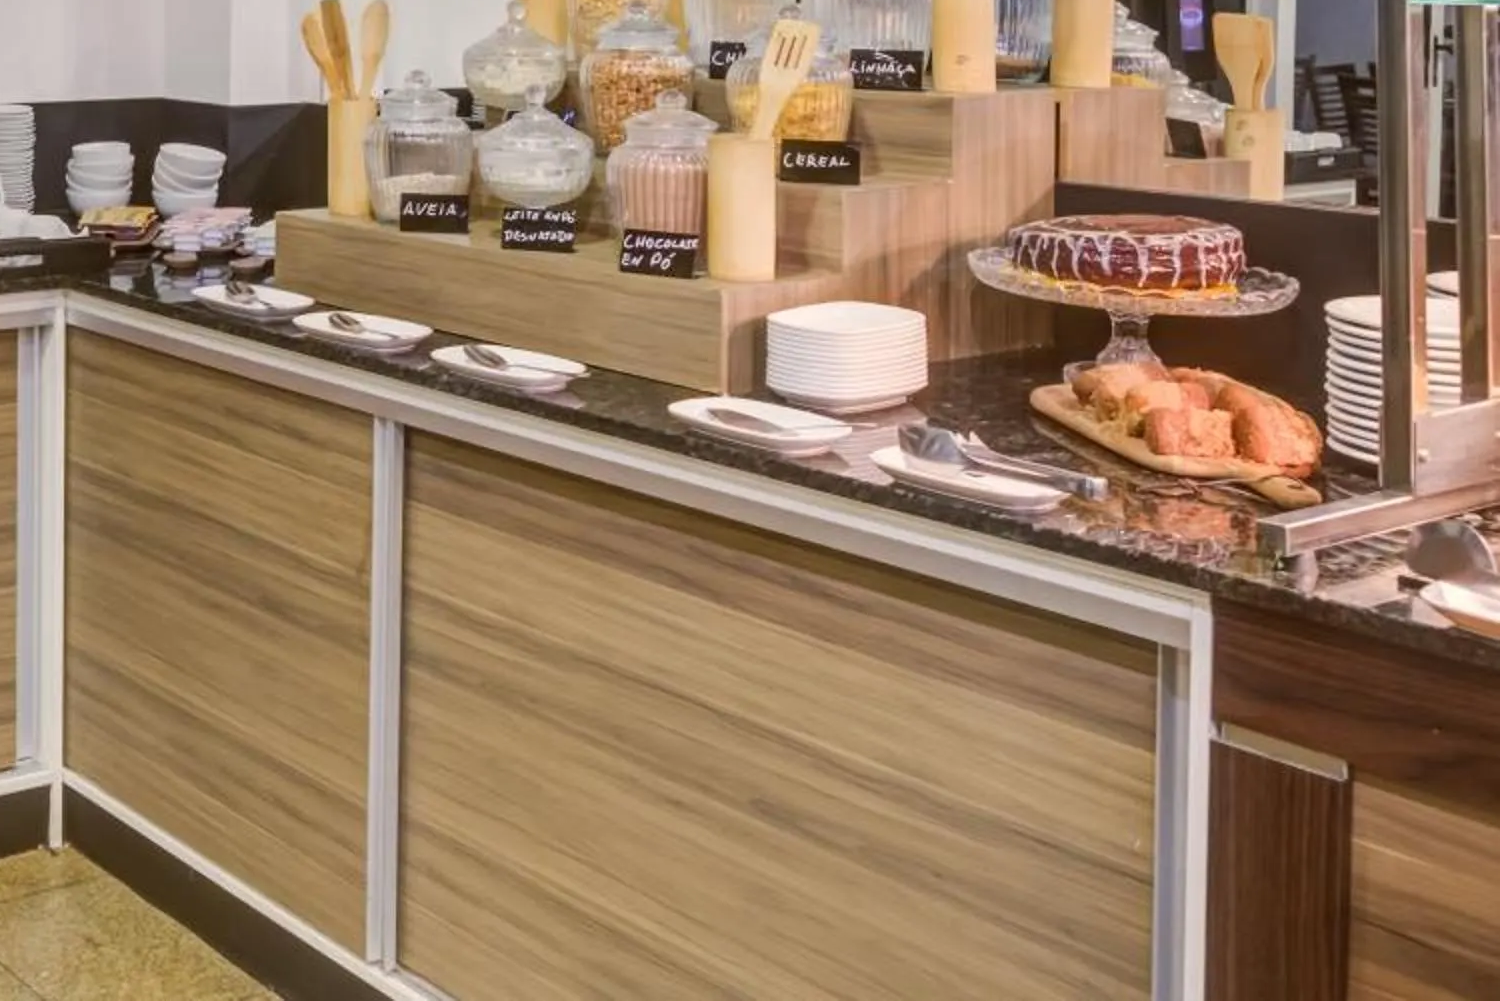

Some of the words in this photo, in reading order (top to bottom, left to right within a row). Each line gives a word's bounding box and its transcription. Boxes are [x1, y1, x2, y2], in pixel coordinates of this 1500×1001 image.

[782, 151, 851, 169] CEREAL
[402, 200, 458, 217] AVEIA
[623, 233, 699, 250] CHOCOLATE
